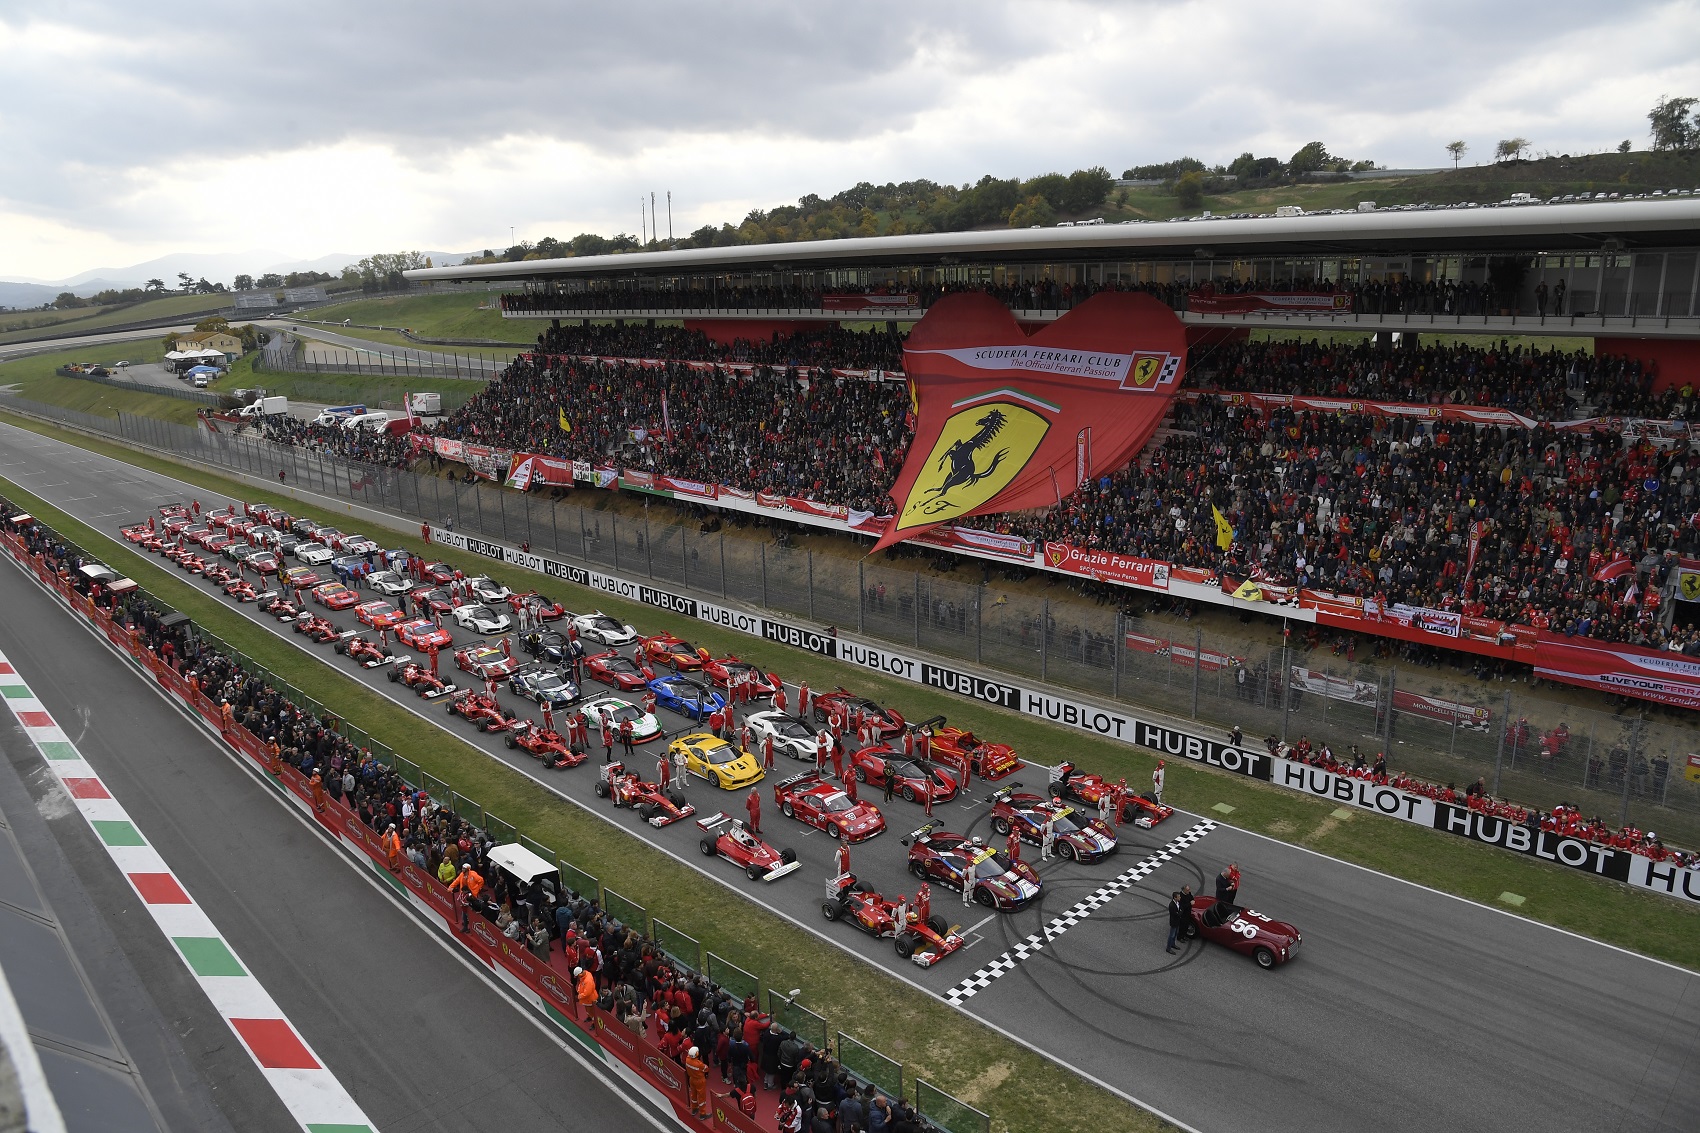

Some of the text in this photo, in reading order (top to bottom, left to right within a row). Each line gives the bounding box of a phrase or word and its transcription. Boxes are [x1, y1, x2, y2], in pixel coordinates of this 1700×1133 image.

[975, 350, 1121, 367] SCUDERIA FERRARI CLUB
[1010, 359, 1116, 377] The Official Ferrari Passion
[435, 530, 465, 548] HUBLOT
[469, 538, 501, 558] HUBLOT
[505, 549, 541, 568] HUBLOT
[547, 560, 585, 580] HUBLOT
[1071, 549, 1154, 573] Grazie Ferrari
[592, 573, 635, 598] HUBLOT
[643, 587, 692, 613] HUBLOT
[701, 601, 756, 633] HUBLOT
[767, 622, 830, 654] HUBLOT
[842, 643, 914, 678] HUBLOT
[1639, 657, 1679, 668] SCUDERIA
[929, 666, 1012, 706] HUBLOT
[1029, 694, 1126, 738] HUBLOT
[1412, 702, 1449, 715] MONTICELLI
[1145, 725, 1260, 775] HUBLOT
[1285, 763, 1421, 819] HUBLOT
[1447, 807, 1615, 874] HUBLOT
[1645, 862, 1700, 902] HU
[1231, 919, 1260, 939] 56
